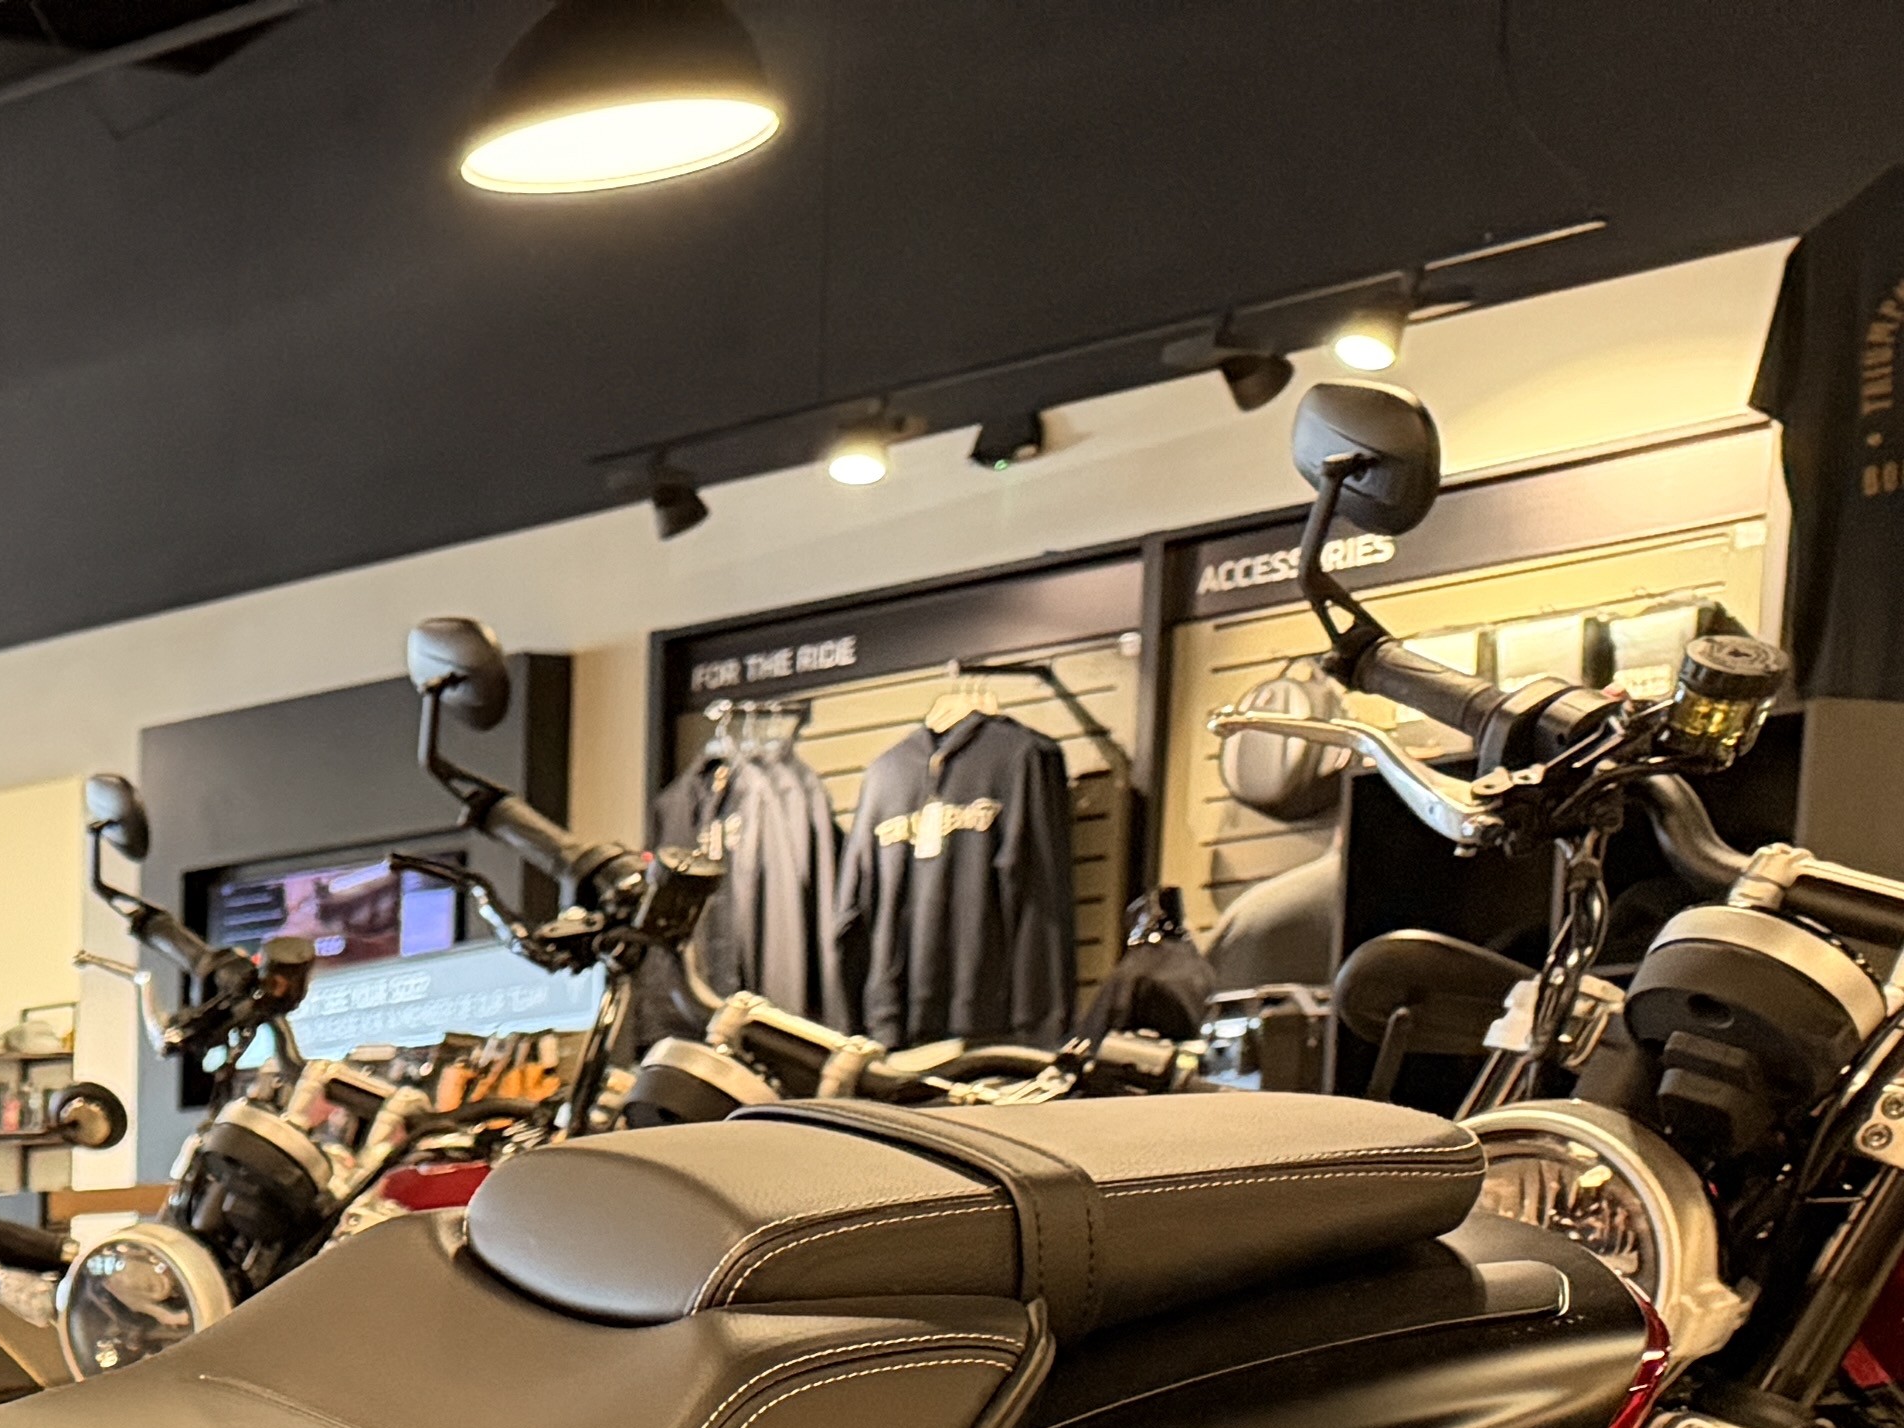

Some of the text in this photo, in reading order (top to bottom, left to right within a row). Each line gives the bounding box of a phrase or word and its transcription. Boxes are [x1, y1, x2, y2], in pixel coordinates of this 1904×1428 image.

[1196, 533, 1396, 595] ACCESSRIES
[691, 634, 857, 692] FOR THE RIDE
